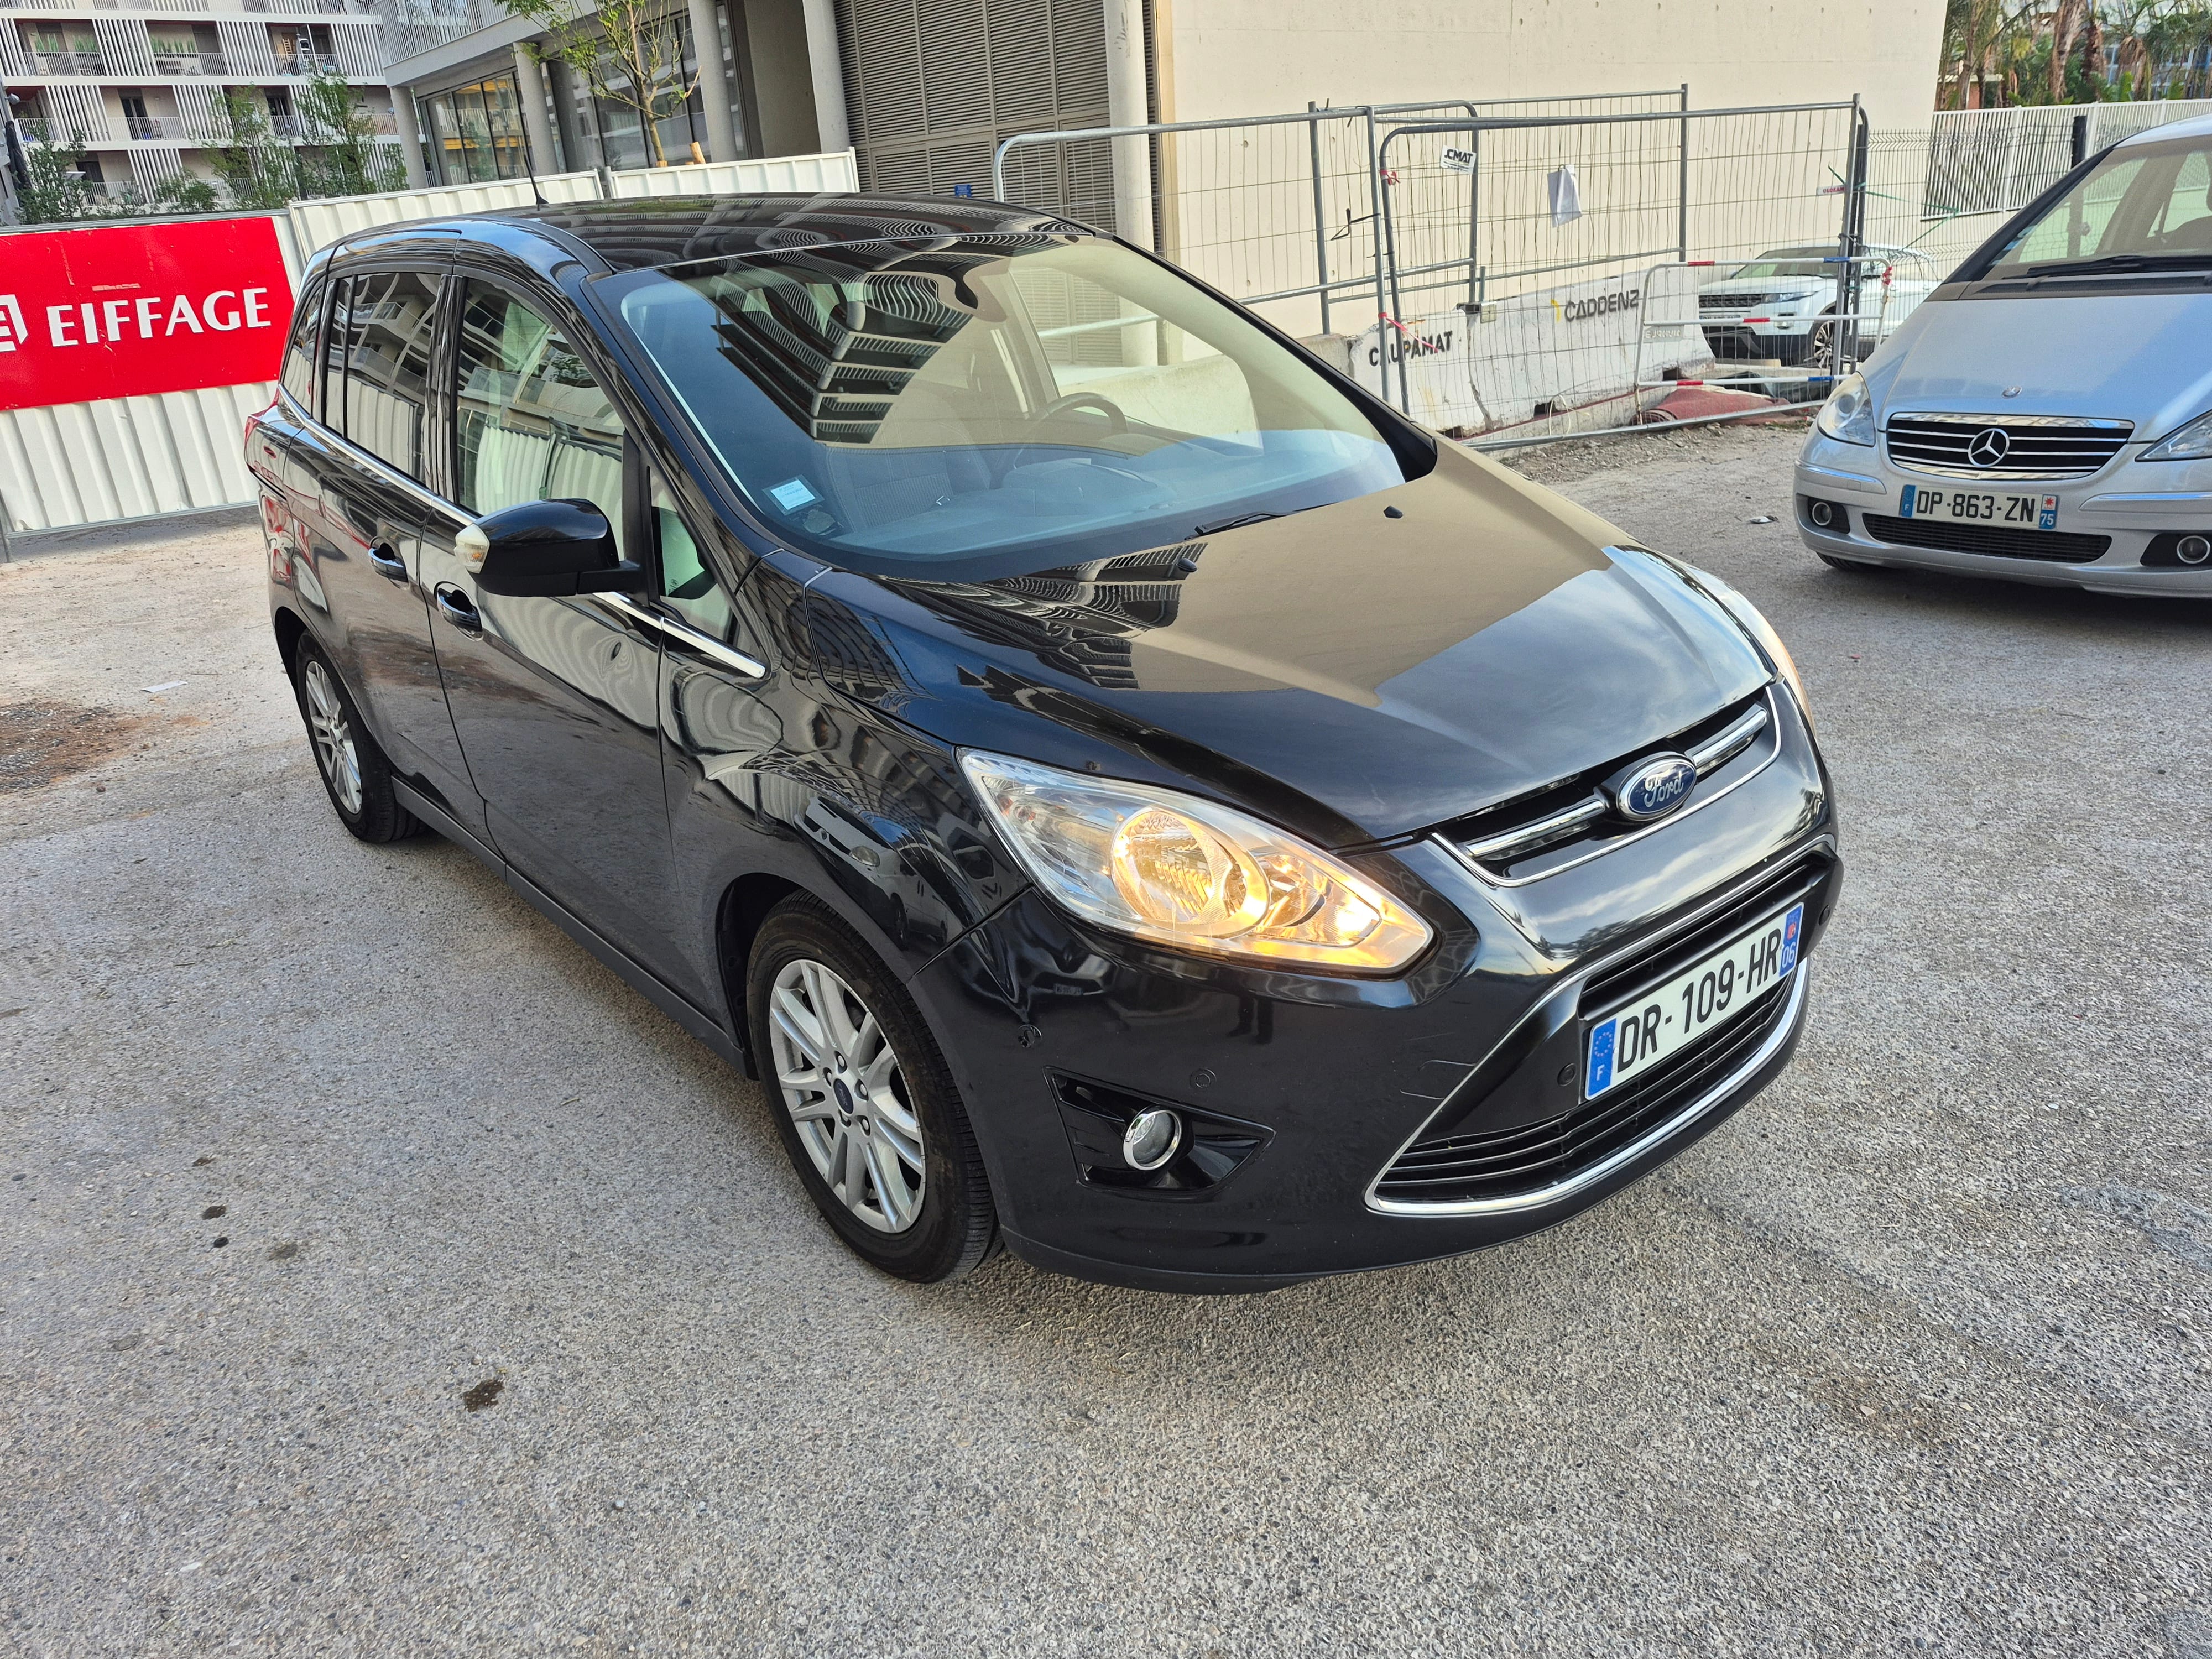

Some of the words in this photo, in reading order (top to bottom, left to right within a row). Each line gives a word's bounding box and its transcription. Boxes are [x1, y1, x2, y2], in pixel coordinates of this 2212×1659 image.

[46, 287, 271, 347] EIFFAGE
[1564, 289, 1639, 322] CADDENZ
[1916, 490, 2035, 522] DP-863-ZN
[2041, 513, 2054, 525] 75
[1644, 769, 1684, 807] Ford
[1596, 1064, 1605, 1081] F
[1617, 928, 1781, 1073] DR-109-HR
[1782, 941, 1796, 968] 06
